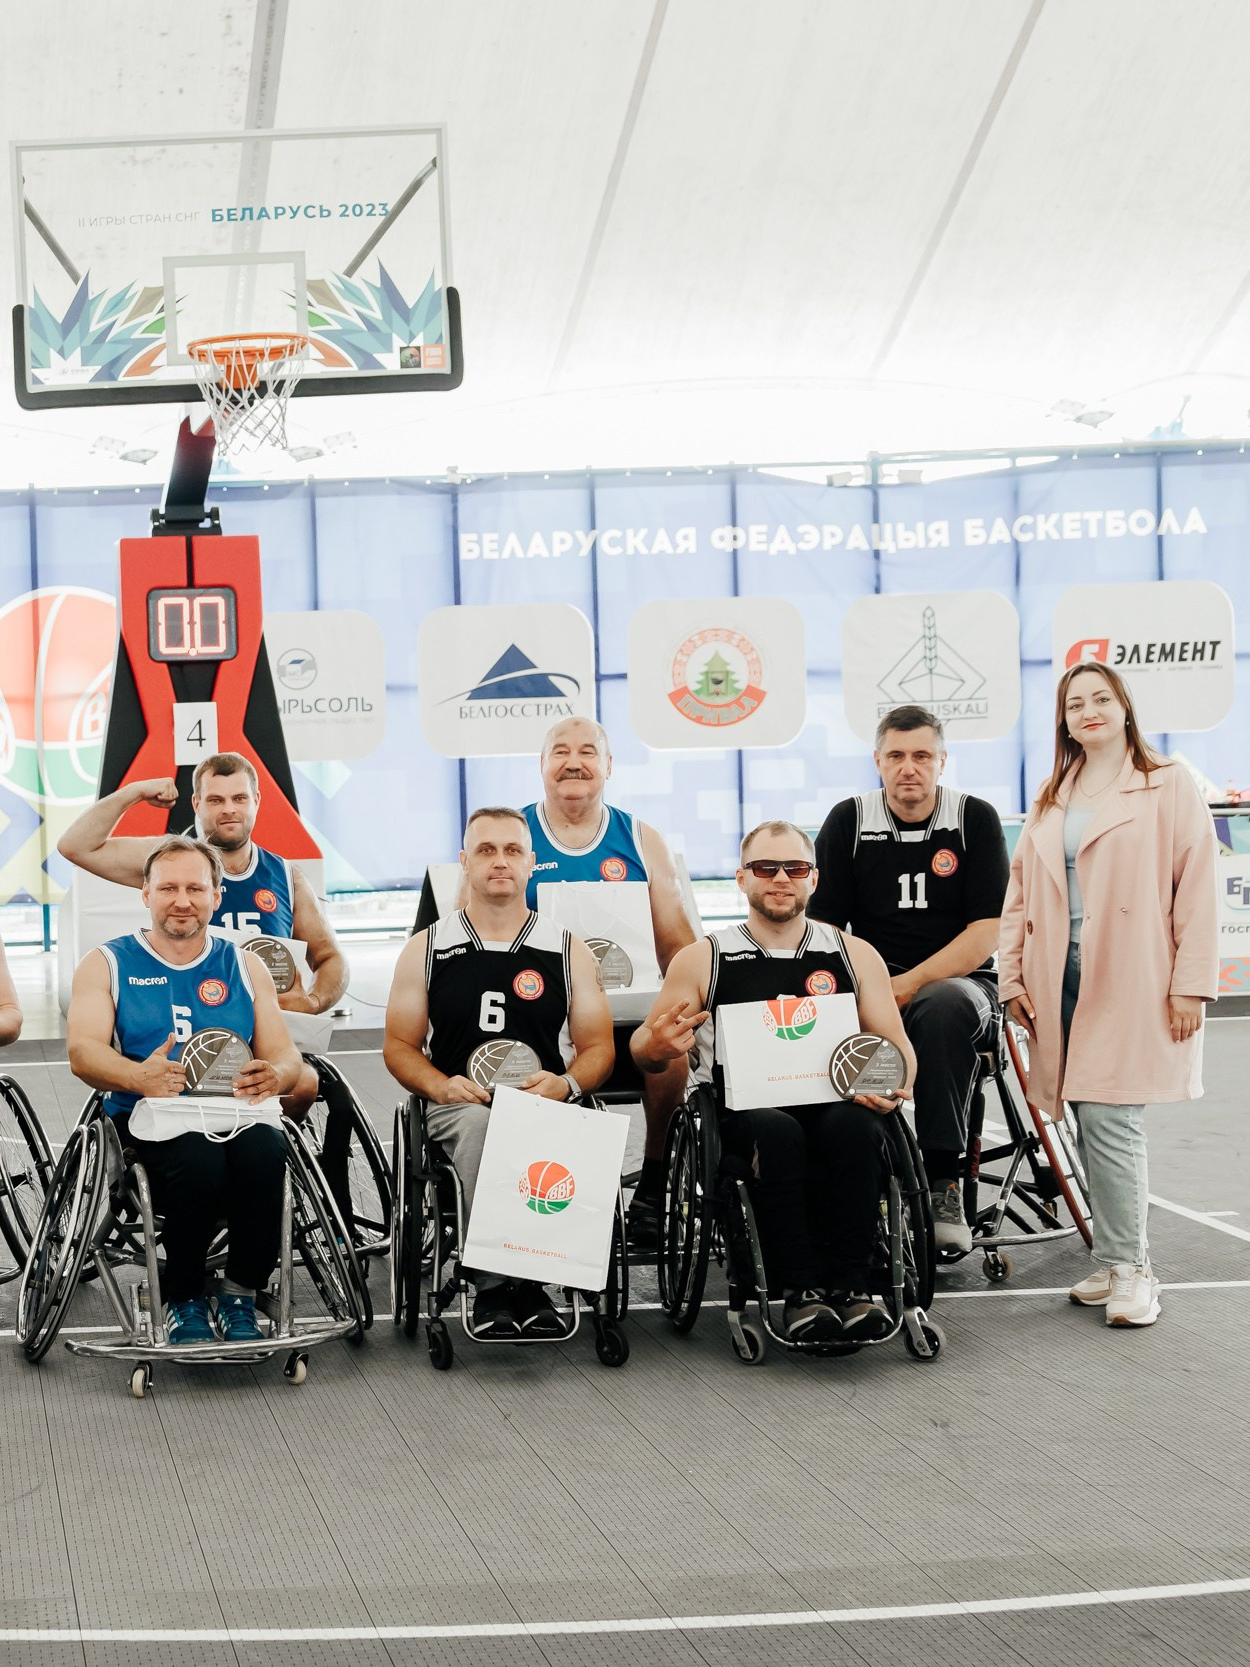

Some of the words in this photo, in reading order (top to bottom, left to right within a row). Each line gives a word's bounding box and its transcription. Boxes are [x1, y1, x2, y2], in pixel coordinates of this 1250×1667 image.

[89, 215, 126, 227] ИГРЫ
[130, 212, 172, 225] СТРАН
[175, 210, 201, 223] СНГ
[211, 204, 332, 222] БЕЛАРУСЬ
[339, 203, 390, 217] 2023
[459, 526, 697, 560] БЕЛАРУСКАЯ
[710, 520, 950, 556] ФЕДЭРАЦЫЯ
[963, 506, 1208, 546] БАСКЕТБОЛА
[1114, 640, 1222, 665] ЭЛЕМЕНТ
[459, 702, 575, 719] БЕЛГОССТРАХ
[186, 718, 207, 748] 4
[897, 871, 929, 909] 11
[436, 947, 467, 960] macron
[725, 952, 757, 962] macron
[128, 976, 168, 986] macron
[171, 1004, 193, 1043] 6
[479, 990, 506, 1033] 6
[794, 998, 816, 1026] BBF
[549, 1177, 574, 1200] BBF
